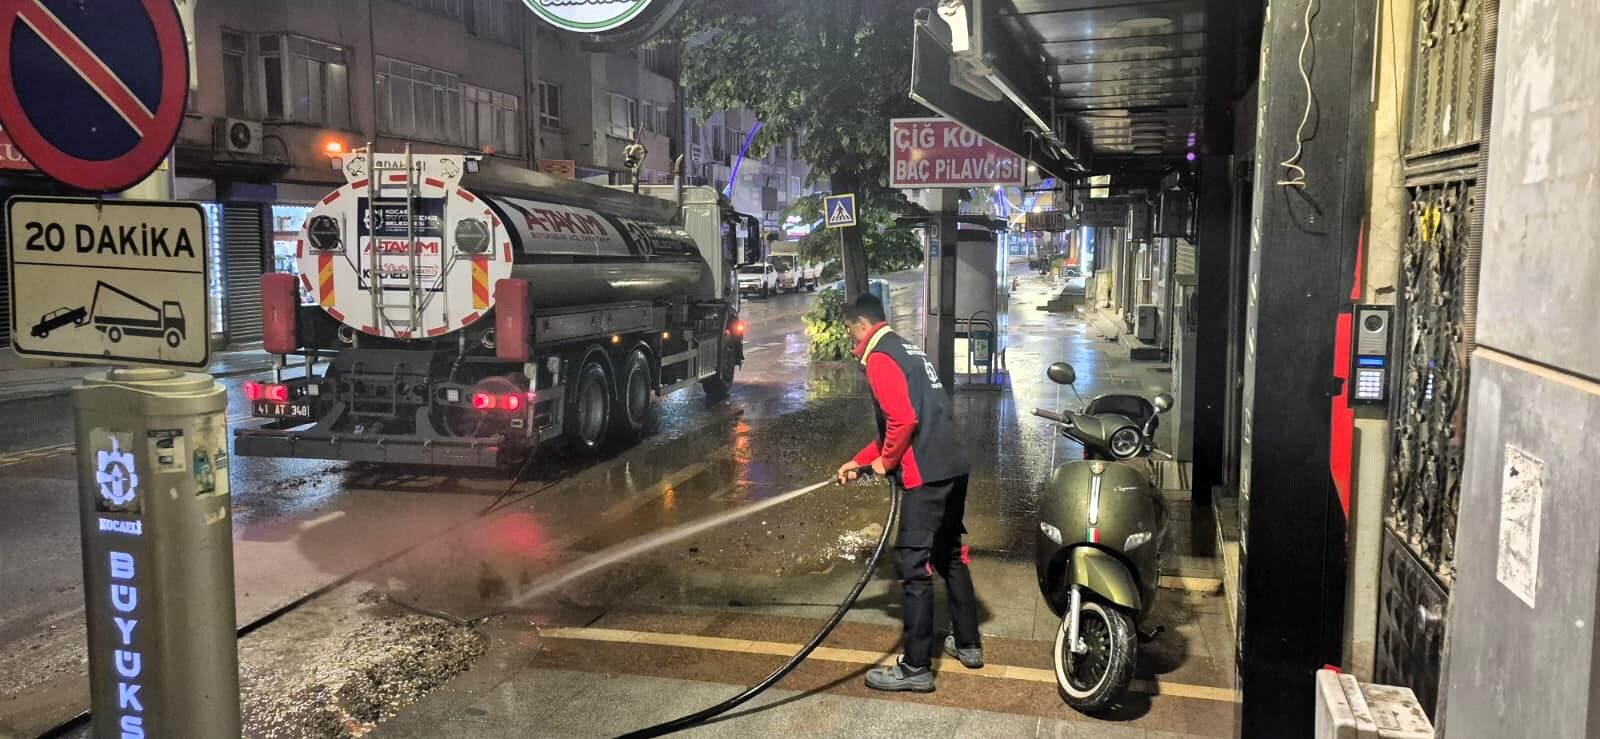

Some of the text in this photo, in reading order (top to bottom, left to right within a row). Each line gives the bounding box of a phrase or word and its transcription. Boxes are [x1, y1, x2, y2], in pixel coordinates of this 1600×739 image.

[896, 122, 935, 151] ÇİĞ
[896, 160, 930, 182] BAÇ
[25, 222, 195, 258] 20 DAKİKA
[258, 404, 307, 416] 41 AT 348
[98, 518, 143, 536] KOCAELİ
